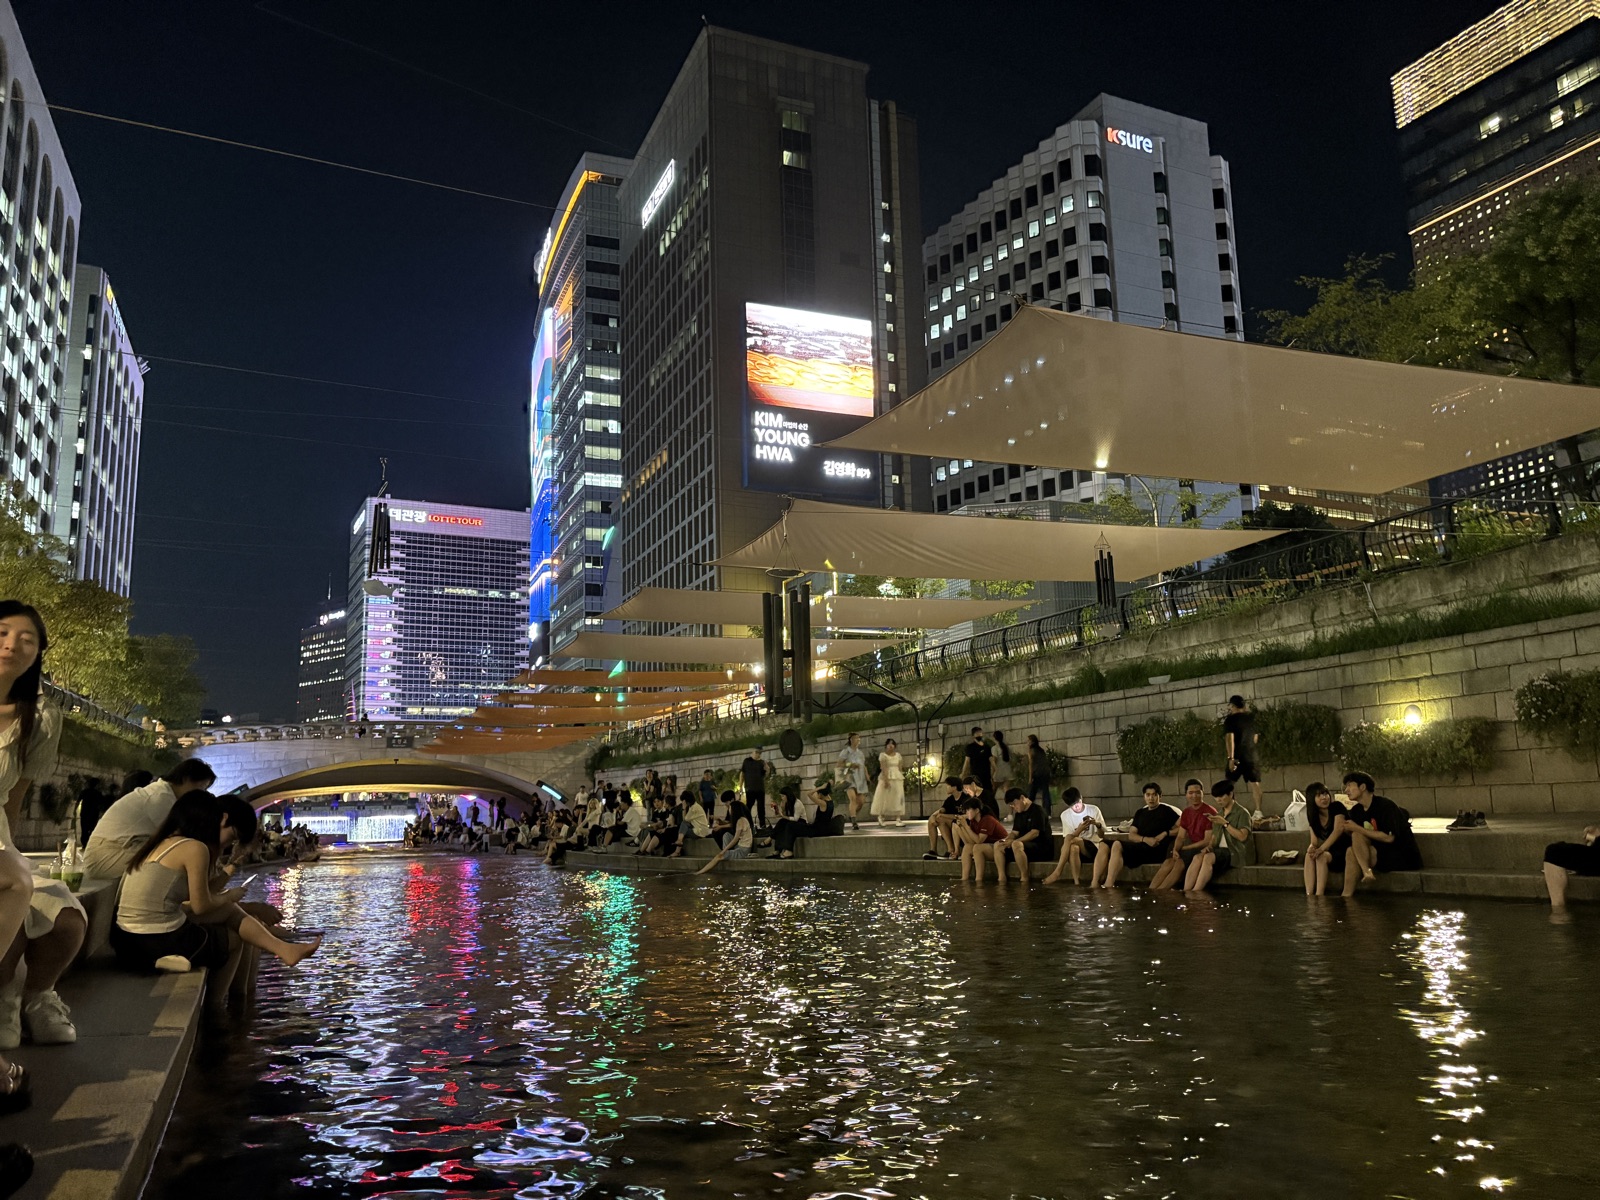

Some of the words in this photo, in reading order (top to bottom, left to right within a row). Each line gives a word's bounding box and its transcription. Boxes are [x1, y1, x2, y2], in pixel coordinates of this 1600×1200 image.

[1106, 127, 1153, 154] Ksure
[754, 410, 783, 428] KIM
[754, 428, 810, 447] YOUNG
[755, 445, 793, 462] HWA
[823, 460, 856, 477] 김영화
[388, 508, 427, 523] 데관광
[428, 514, 456, 524] LOTTE
[456, 517, 482, 526] TOUR
